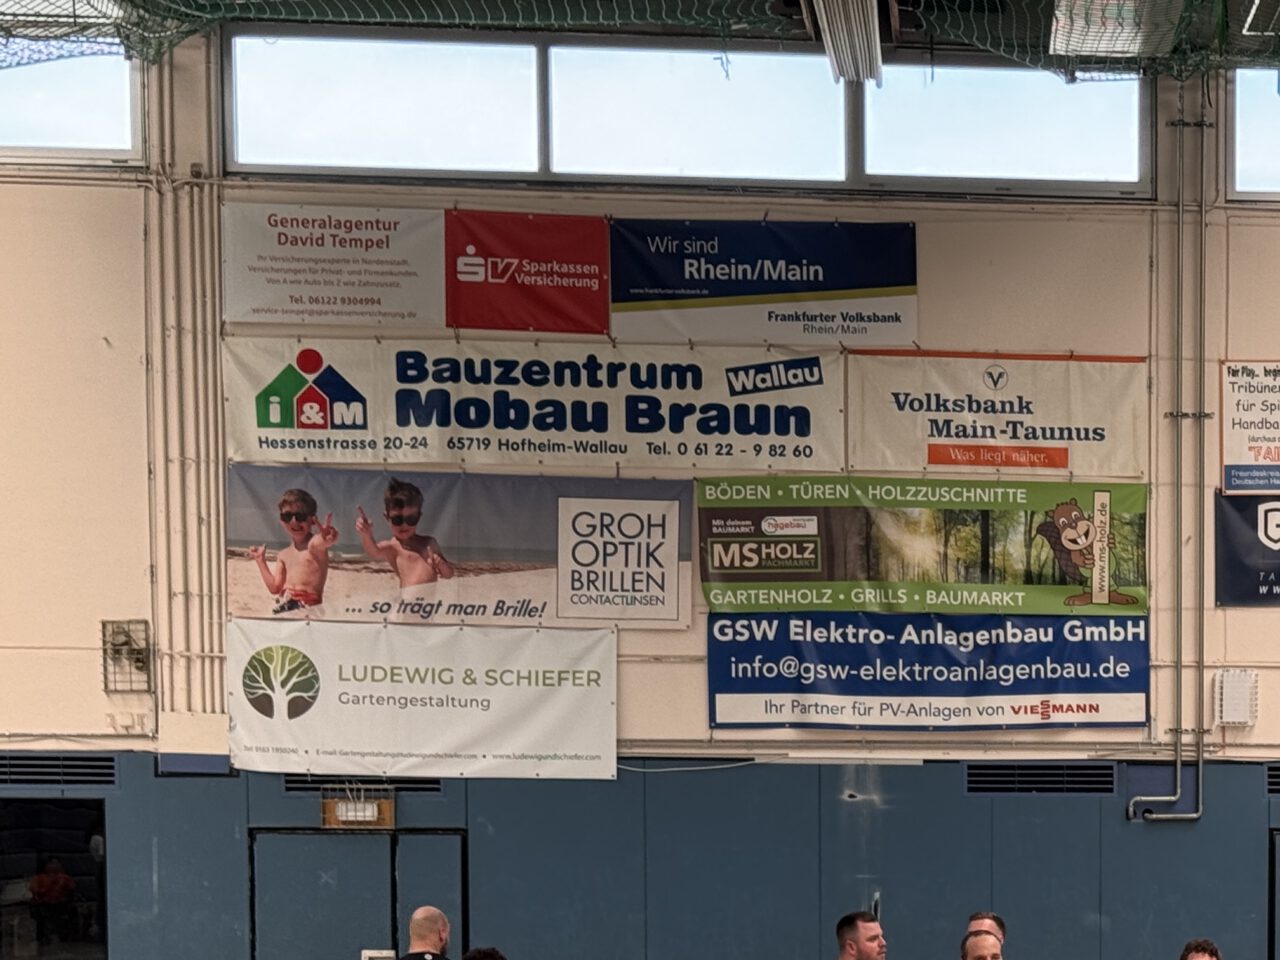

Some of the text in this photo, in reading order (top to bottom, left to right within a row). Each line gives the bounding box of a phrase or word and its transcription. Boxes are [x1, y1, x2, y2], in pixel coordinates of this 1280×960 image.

[268, 213, 400, 234] Generalagentur
[277, 232, 390, 252] David Tempel
[647, 236, 719, 254] Wir sind
[522, 259, 599, 274] Sparkassen
[684, 258, 824, 281] Rhein/Main
[515, 272, 599, 290] Versicherung
[289, 295, 306, 305] Tel.
[768, 311, 902, 323] Frankfurter Volksbank
[803, 324, 868, 334] Rhein/Main
[395, 351, 703, 390] Bauzentrum
[728, 363, 822, 393] Wallau
[395, 388, 811, 438] Mobau Braun
[891, 391, 1034, 415] Volksbank
[1235, 400, 1256, 412] für
[927, 418, 1106, 442] Main-Taunus
[258, 436, 814, 458] Hessenstrasse 20-24 65719 Hofheim-Wallau Tel. 0 61 22 9 82 60
[949, 448, 1048, 465] Was liegt näher.
[705, 482, 1027, 504] BÖDEN TÜREN HOLZZUSCHNITTE
[572, 511, 666, 540] GROH
[768, 521, 806, 532] hagebau
[572, 540, 665, 568] OPTIK
[713, 543, 816, 568] MS HOLZ
[1098, 502, 1108, 594] www.ms-holz.de
[571, 570, 665, 592] BRILLEN
[370, 597, 547, 619] so trägt man Brille!
[570, 594, 665, 606] CONTACTLINSEN
[710, 588, 1026, 606] GARTENHOLZ GRILLS BAUMARKT
[713, 619, 1146, 652] GSW Elektro- Anlagenbau GmbH
[338, 664, 601, 688] LUDEWIG & SCHIEFER
[731, 655, 1130, 686] info@gsw-elektroanlagenbau.de
[338, 691, 492, 712] Gartengestaltung
[764, 700, 1100, 721] Ihr Partner für PV-Anlagen von VIESSMANN
